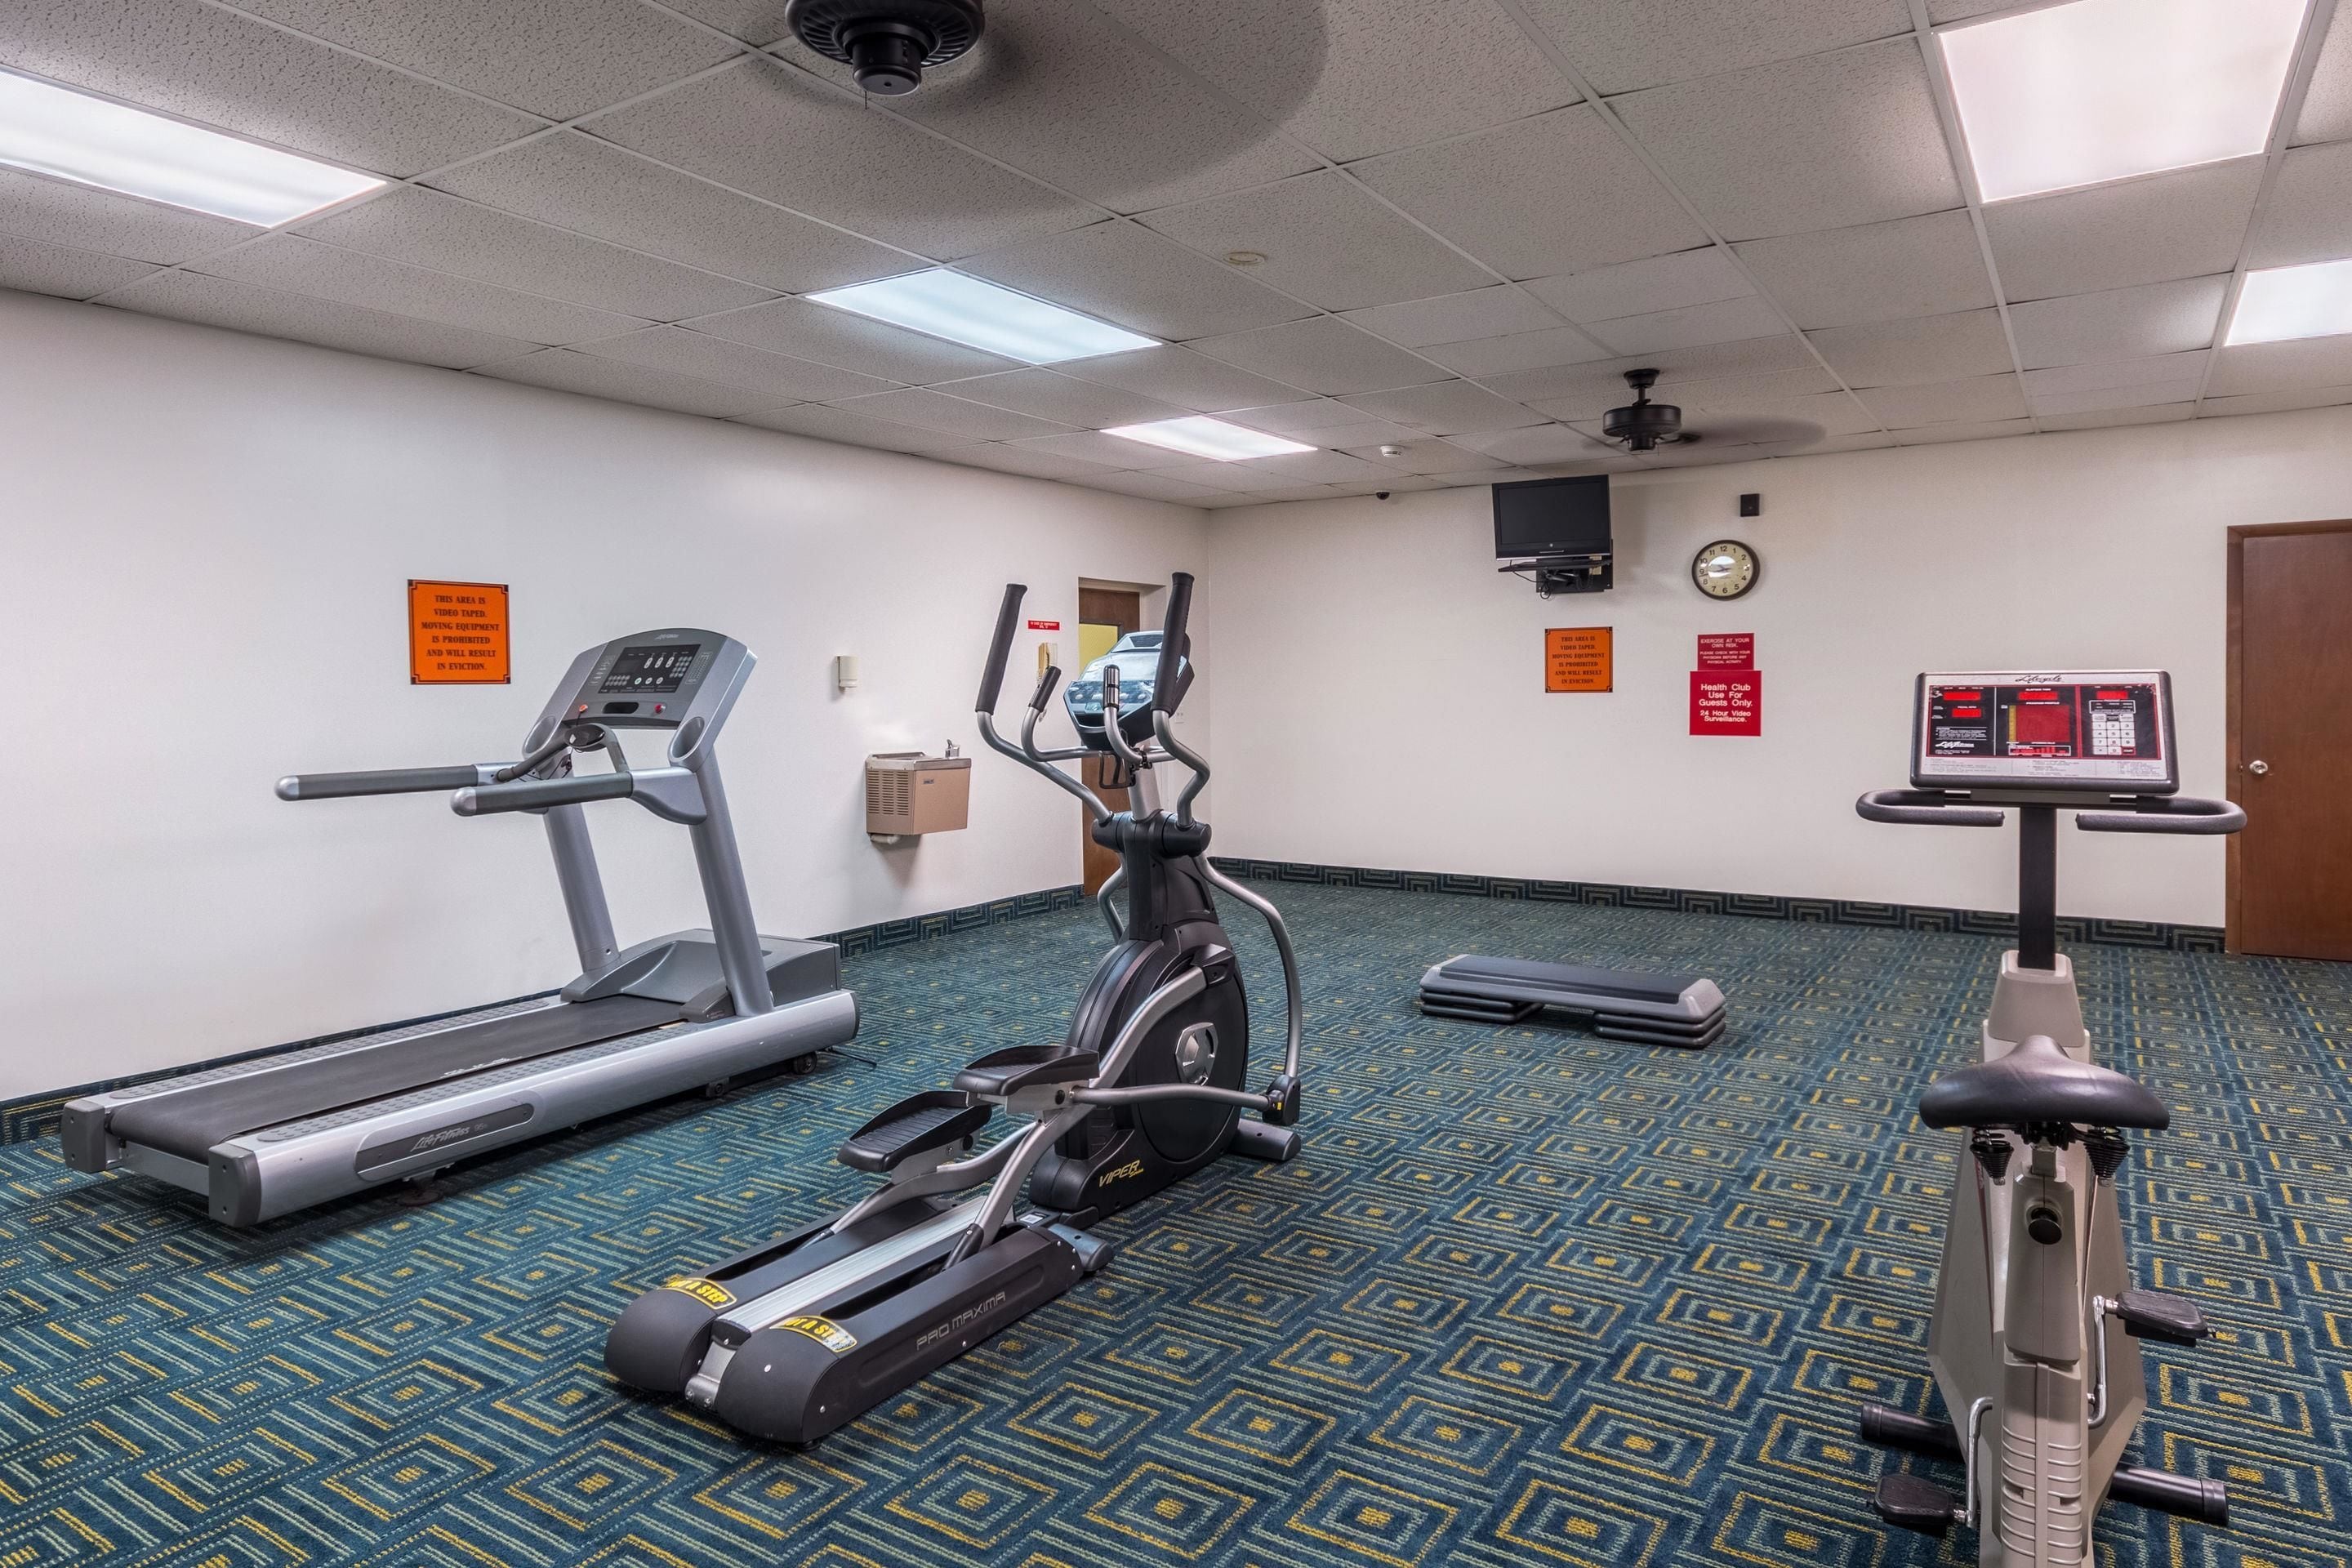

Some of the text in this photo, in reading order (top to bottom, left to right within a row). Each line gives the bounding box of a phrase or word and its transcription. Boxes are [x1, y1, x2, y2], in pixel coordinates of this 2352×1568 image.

[457, 596, 475, 604] AREA
[434, 608, 488, 617] VIDEO TAPED.
[421, 621, 500, 631] MOVING EQUIPMENT
[443, 635, 490, 644] PROHIBITED
[445, 649, 466, 657] WILL
[469, 649, 497, 657] RESULT
[449, 662, 487, 670] EVICTION.
[1731, 699, 1753, 708] Only.
[1099, 1160, 1140, 1187] VIPER
[696, 1285, 728, 1303] STEP
[801, 1320, 817, 1330] A
[916, 1291, 1005, 1351] PRO MAXIMA
